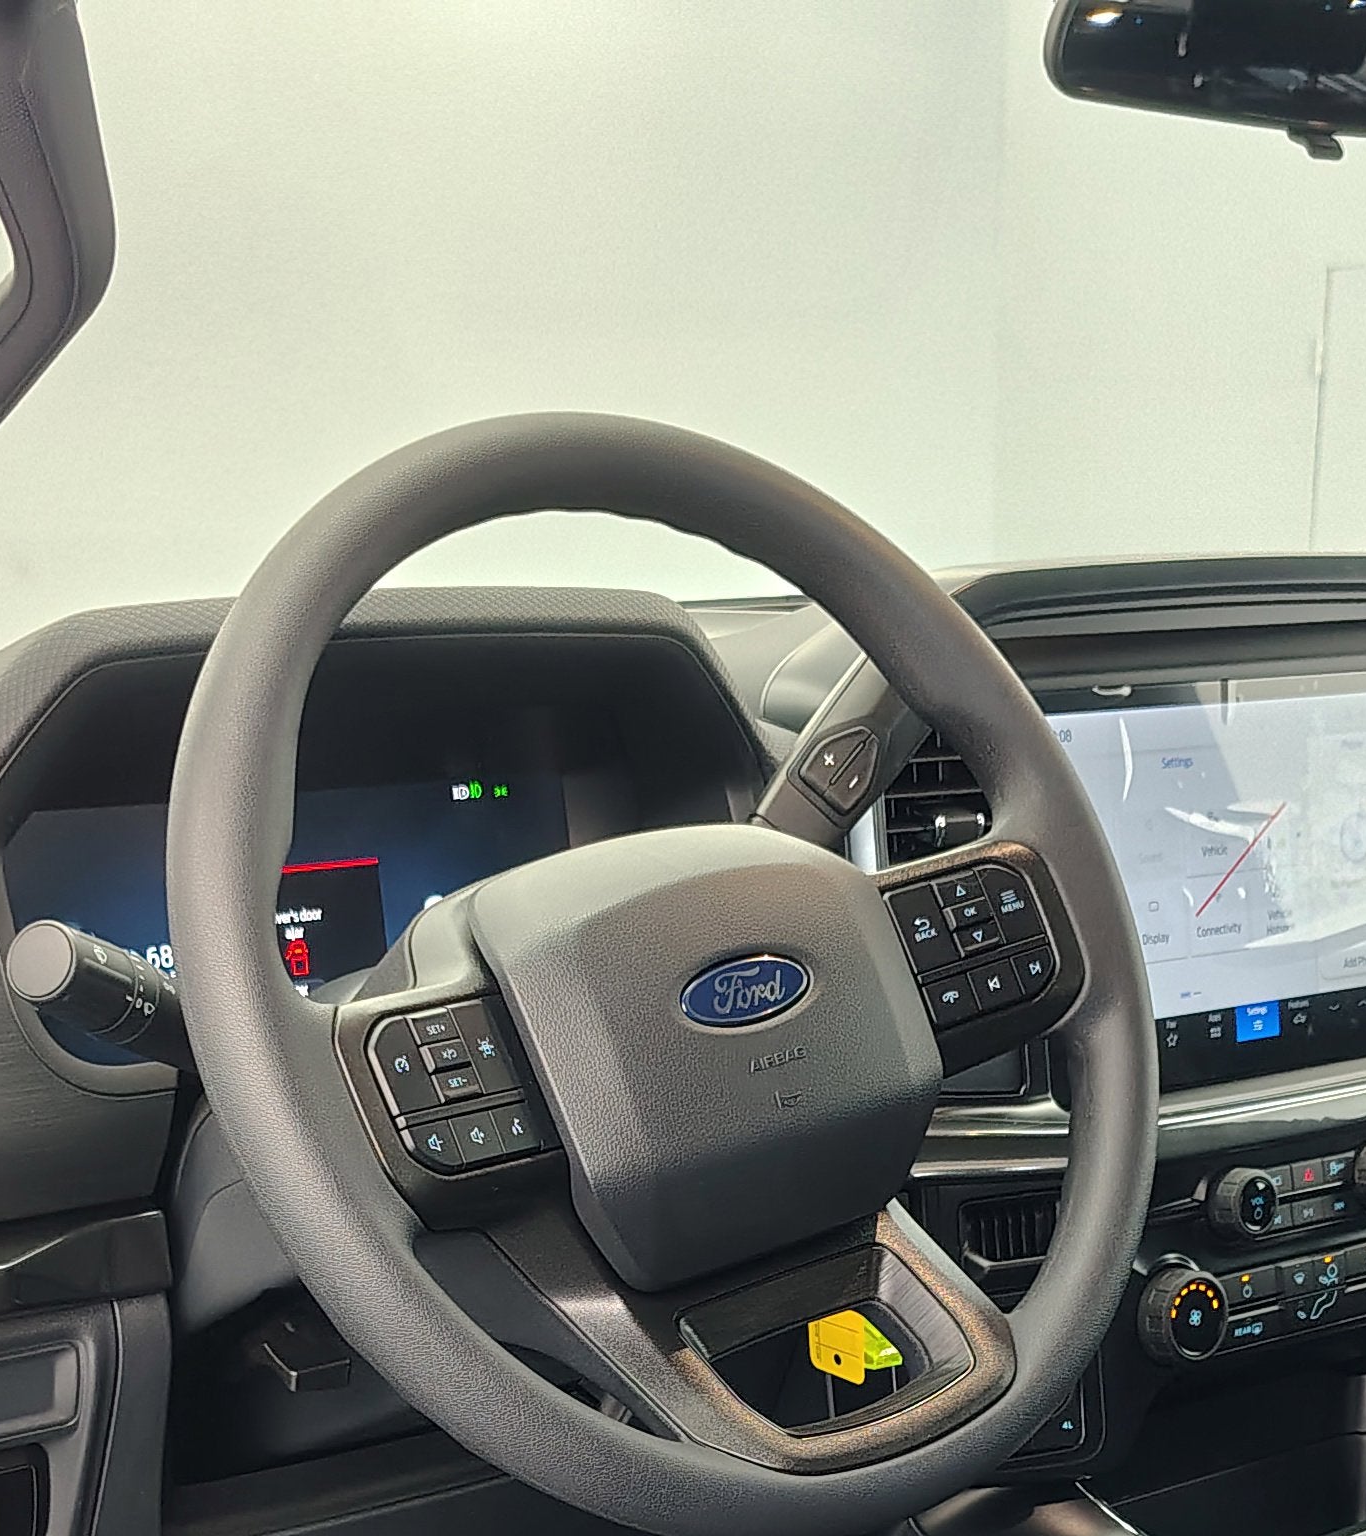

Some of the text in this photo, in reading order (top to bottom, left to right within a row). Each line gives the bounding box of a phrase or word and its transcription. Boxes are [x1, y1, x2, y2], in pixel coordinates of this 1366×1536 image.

[1161, 756, 1194, 769] Settings
[1201, 843, 1228, 858] Vehicle
[299, 906, 323, 922] door
[963, 906, 977, 918] OK
[1000, 900, 1025, 915] MENU
[915, 927, 938, 943] BACK
[1196, 922, 1242, 938] Connectivity
[1142, 931, 1170, 947] Display
[1343, 957, 1357, 969] Add
[713, 964, 786, 1015] Ford
[748, 1046, 809, 1075] AIRBAG
